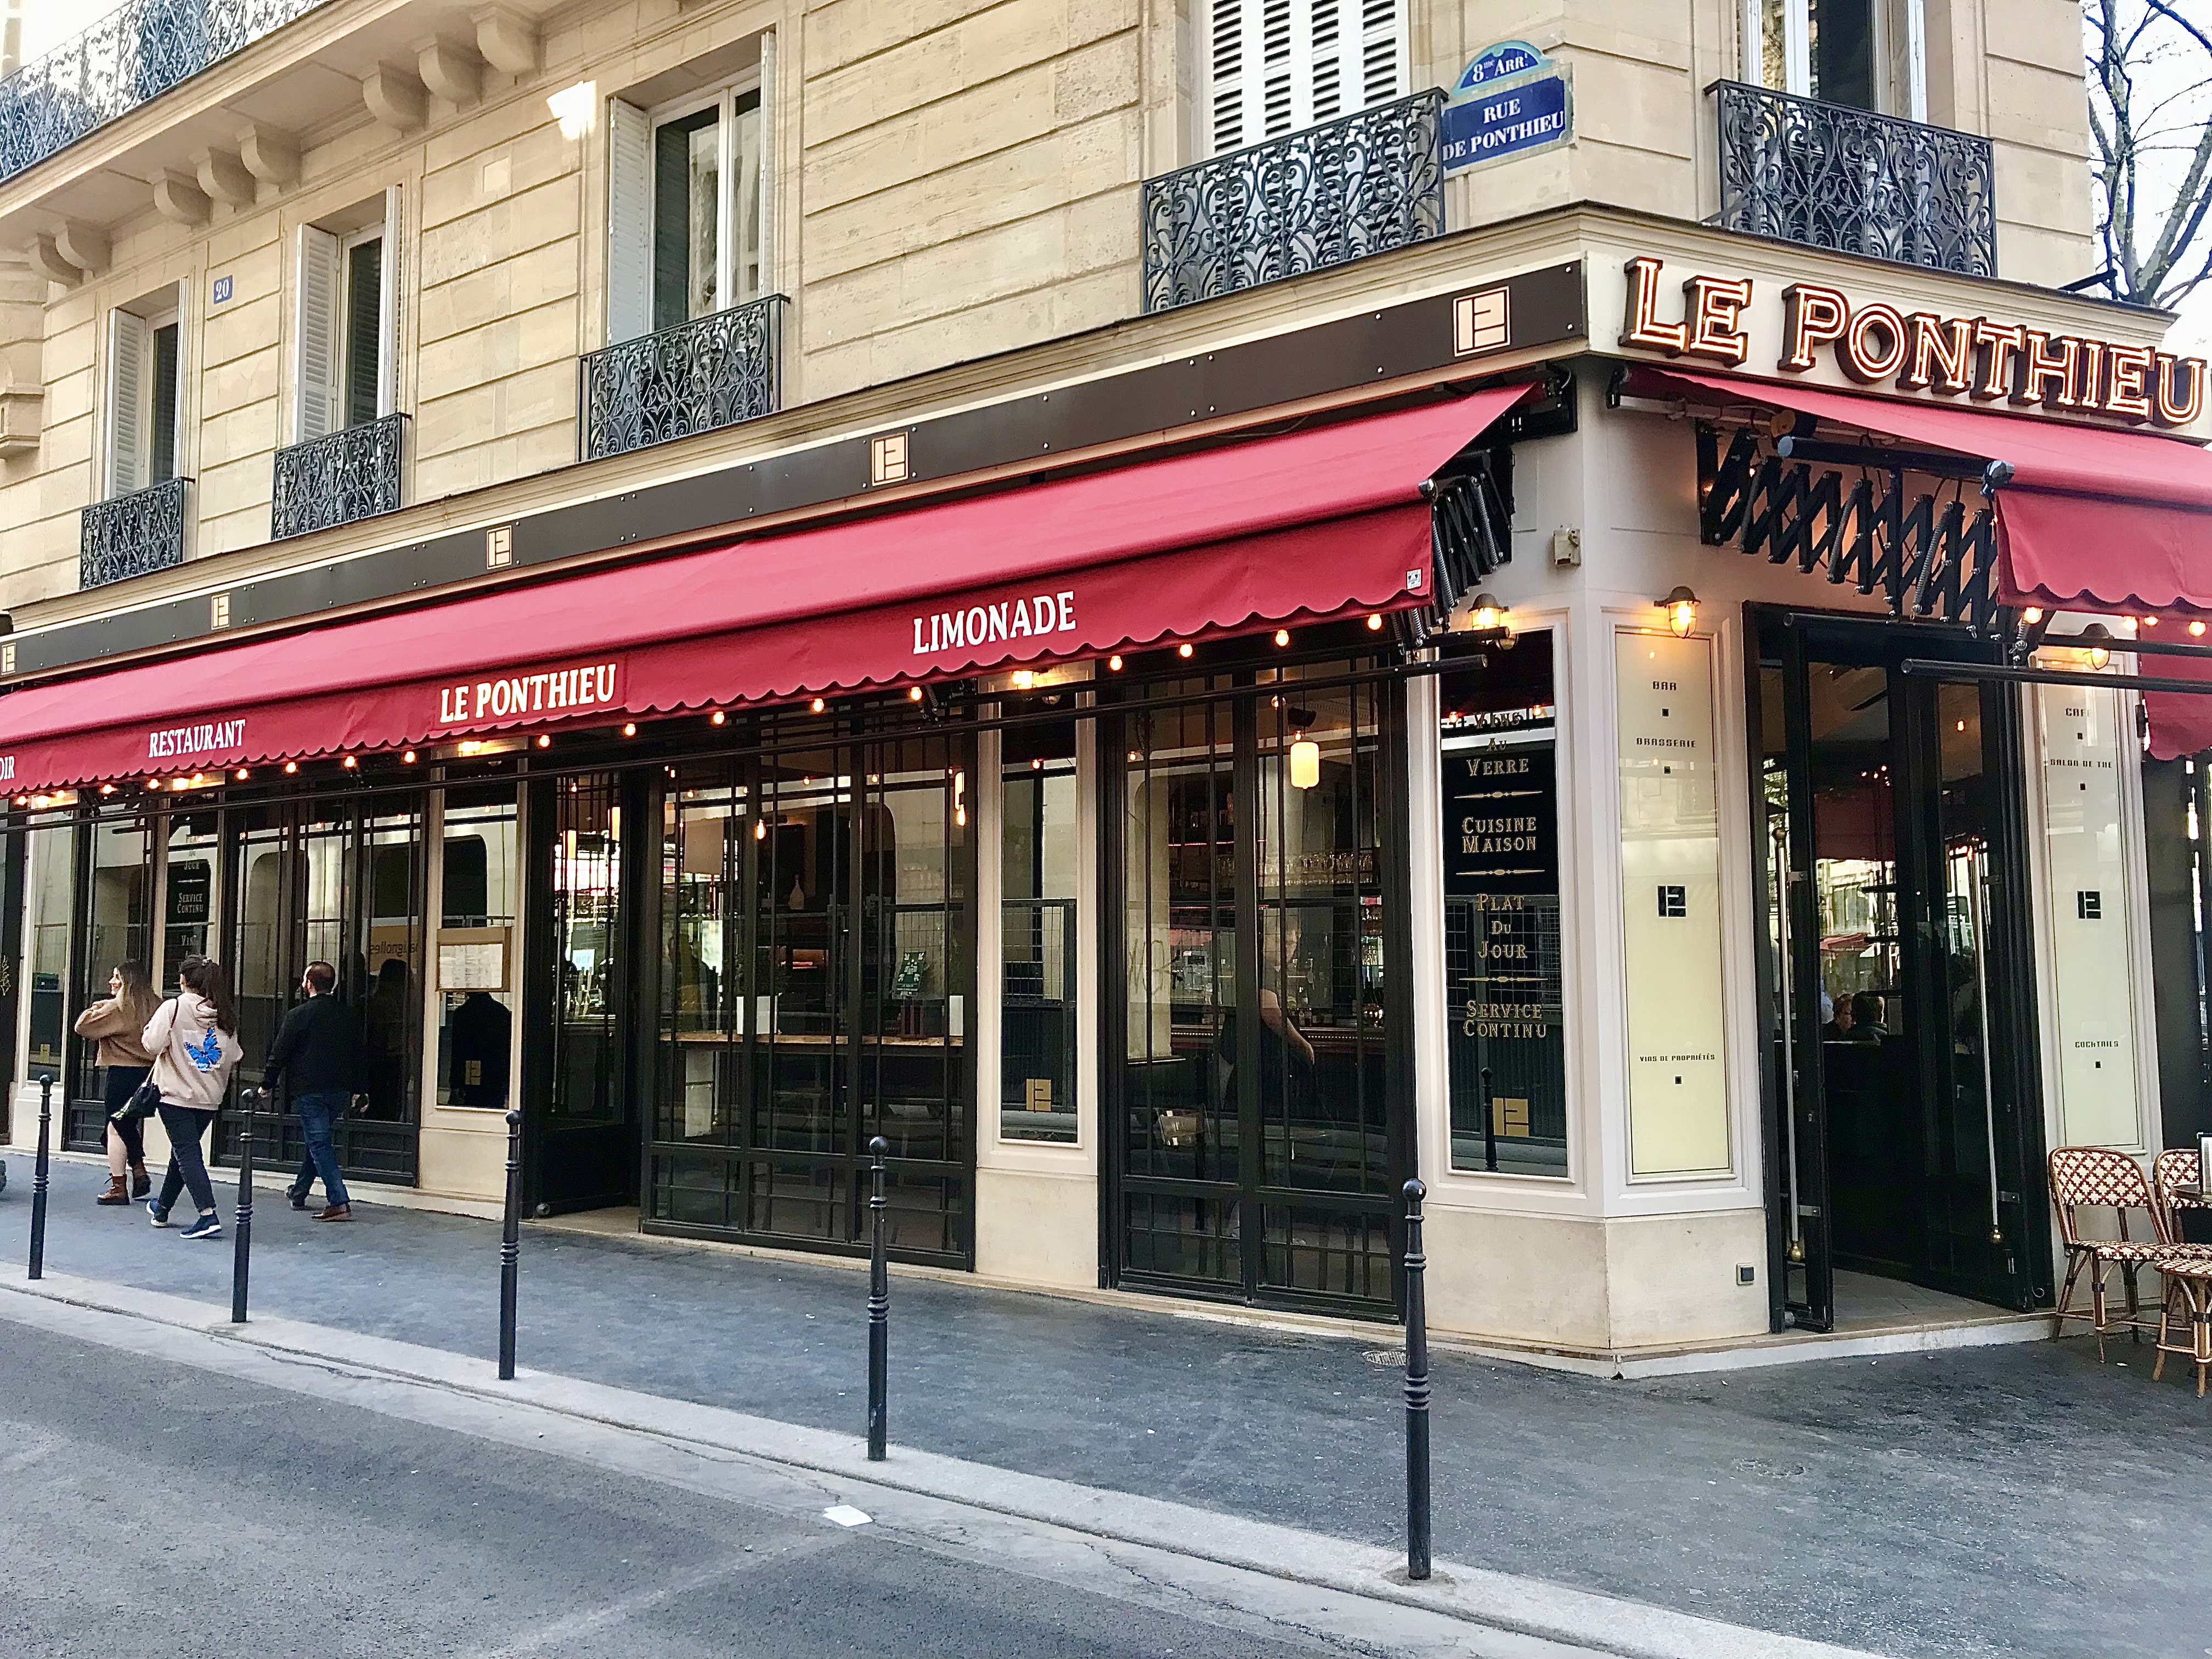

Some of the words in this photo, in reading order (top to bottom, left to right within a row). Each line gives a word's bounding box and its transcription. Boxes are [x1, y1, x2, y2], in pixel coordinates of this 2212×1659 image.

[1483, 98, 1521, 125] RUE
[1442, 141, 1466, 161] DE
[1470, 110, 1565, 154] PONTHIEU
[216, 279, 229, 301] 20
[1618, 256, 1753, 368] LE
[1777, 282, 2209, 427] PONTHIEU
[913, 590, 1076, 654] LIMONADE
[439, 686, 469, 723] LE
[475, 663, 617, 719] PONTHIEU
[1652, 680, 1677, 691] BAR
[148, 719, 246, 758] RESTAURANT
[1636, 737, 1696, 748] BRASSERIE
[1466, 758, 1529, 776] VERRE
[1462, 816, 1537, 834] CUISINE
[1462, 835, 1537, 853] MAISON
[178, 893, 202, 902] SERVICE
[1476, 893, 1525, 911] PLAT
[1491, 921, 1511, 935] DU
[1477, 941, 1527, 958] JOUR
[1466, 1000, 1543, 1019] SERVICE
[1463, 1019, 1547, 1039] CONTINU
